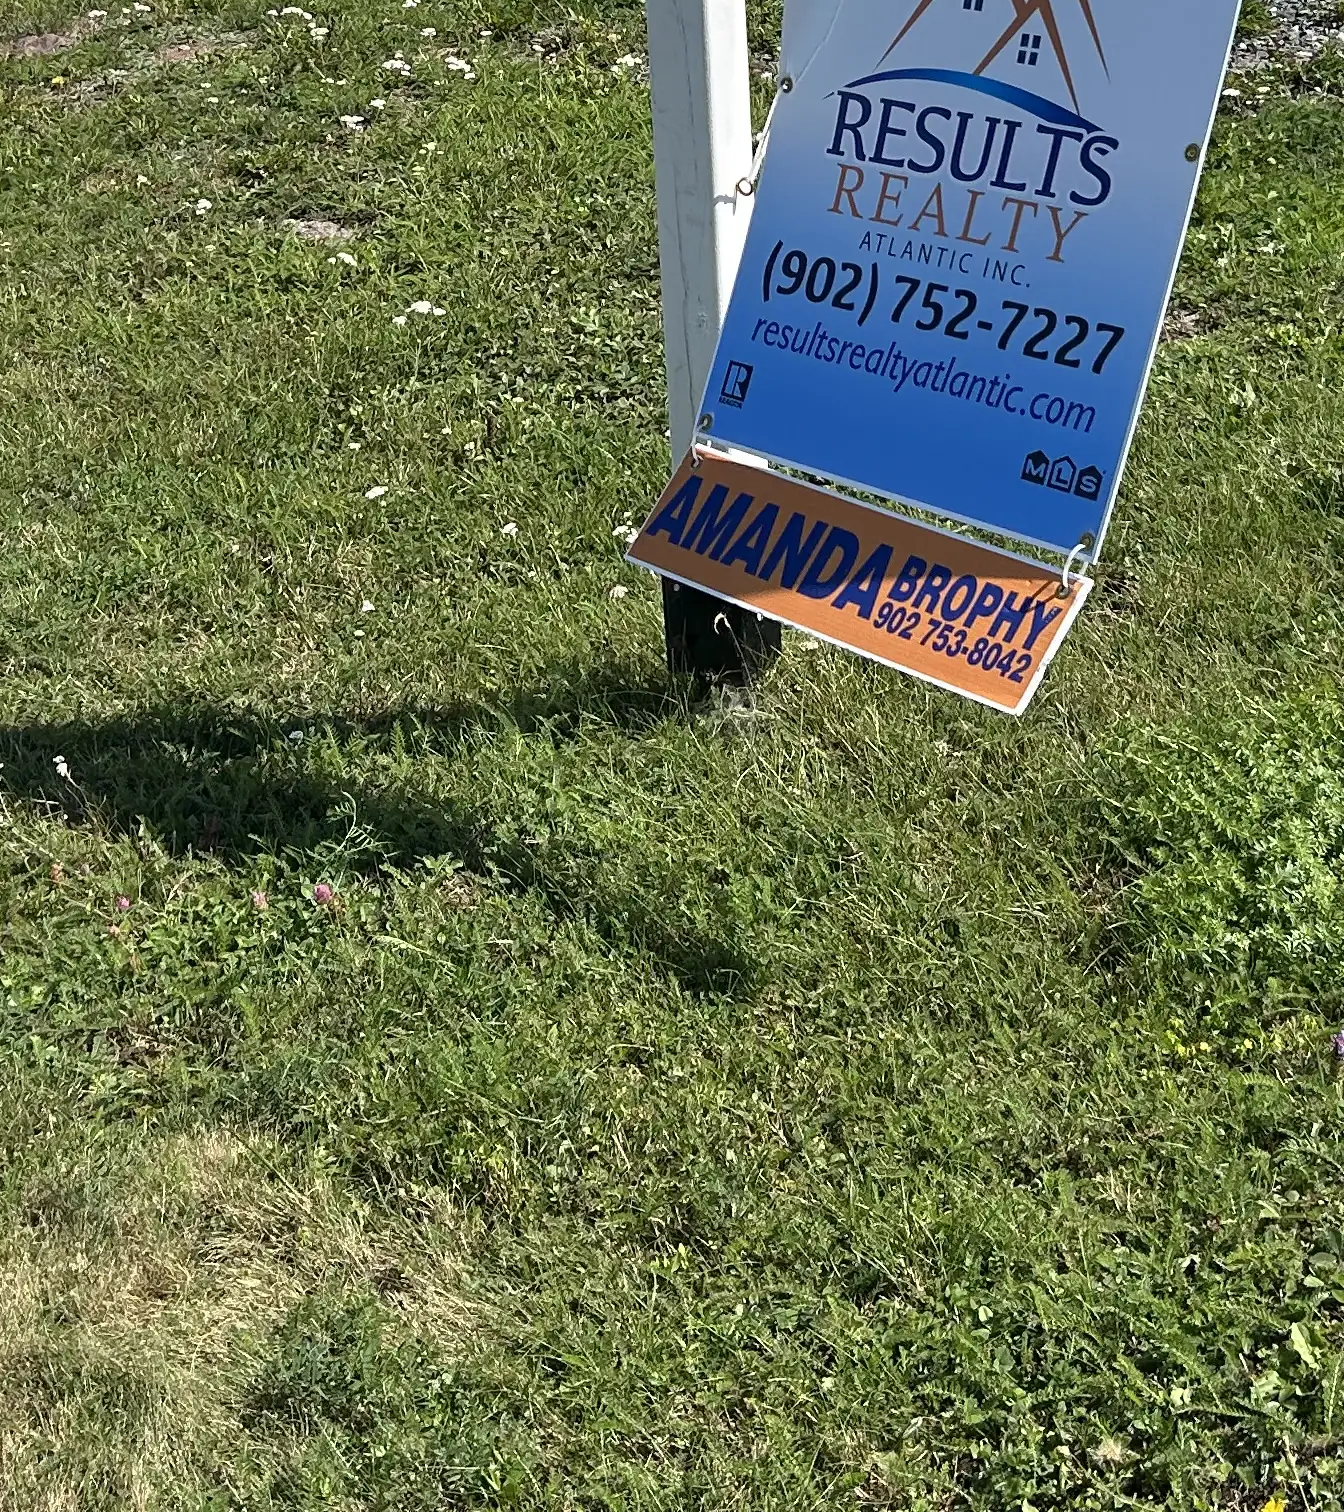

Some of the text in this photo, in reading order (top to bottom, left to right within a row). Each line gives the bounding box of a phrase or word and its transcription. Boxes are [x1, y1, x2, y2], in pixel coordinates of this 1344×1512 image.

[826, 90, 1119, 206] RESULTS
[827, 163, 1089, 263] REALTY
[858, 231, 1031, 287] ATLANTIC INC.
[762, 240, 1125, 375] (902) 752-7227
[751, 317, 1097, 433] resultsrealtyatlantic.com
[647, 475, 1063, 651] AMANDA BROPHY
[873, 602, 1034, 683] 902 753-8042
